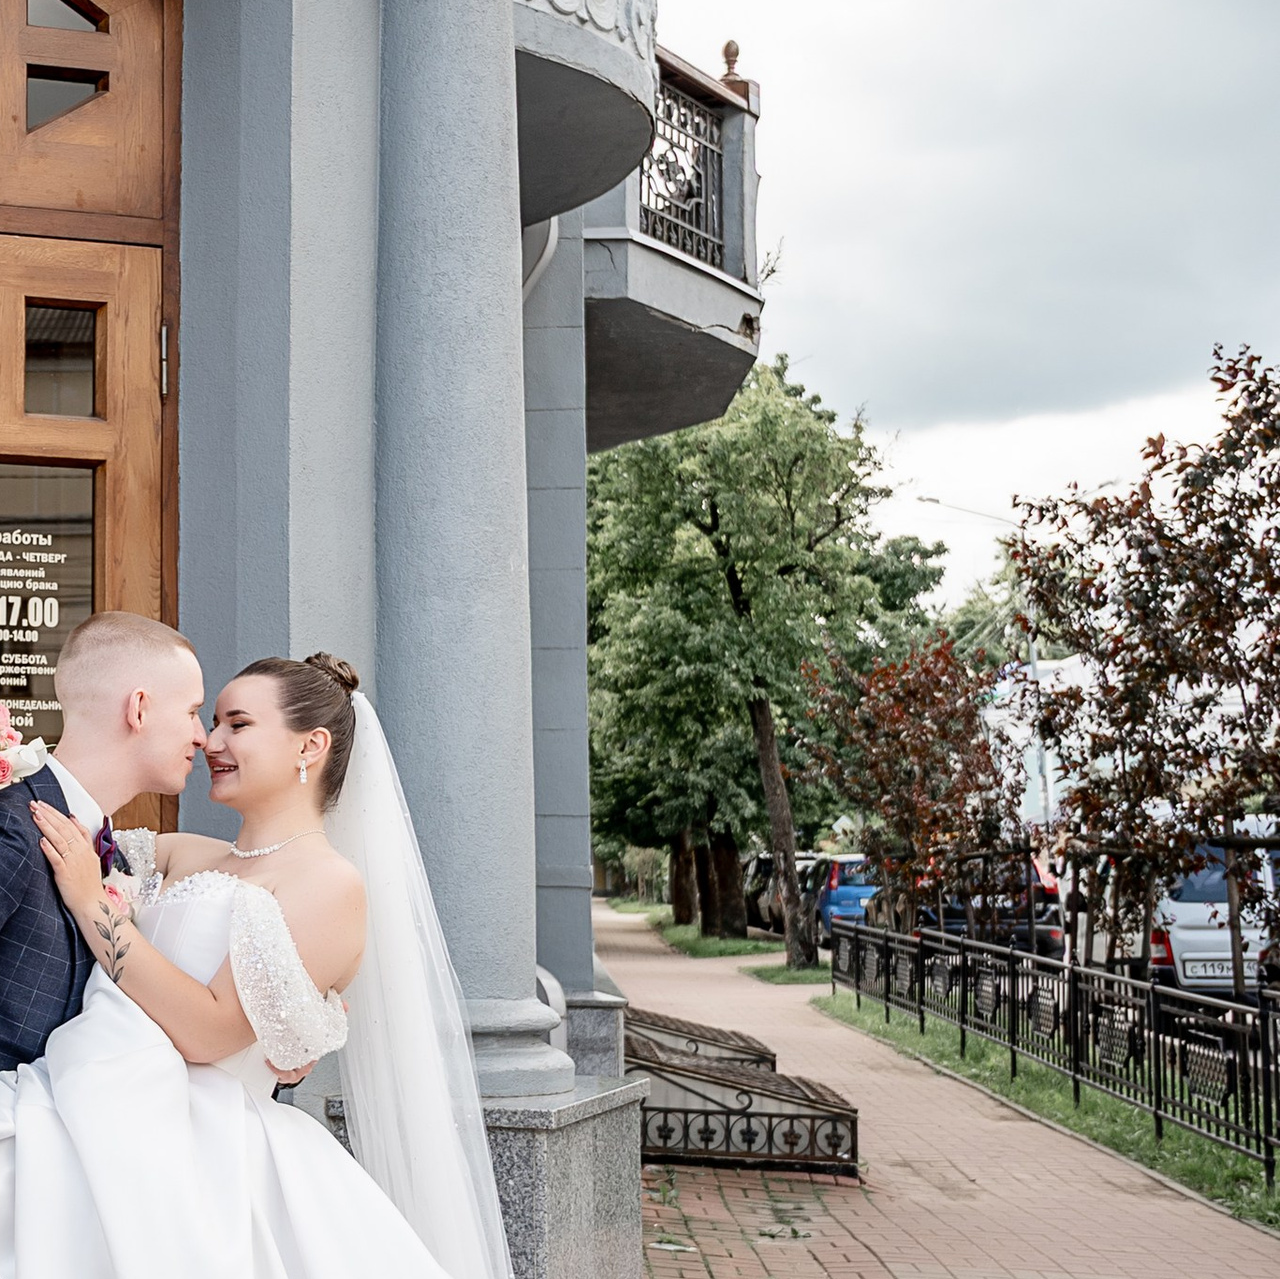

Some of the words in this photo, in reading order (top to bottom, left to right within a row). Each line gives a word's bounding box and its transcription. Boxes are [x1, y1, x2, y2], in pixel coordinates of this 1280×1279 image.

[22, 552, 67, 564] ЧЕТВЕРГ
[25, 579, 58, 591] брака
[1, 653, 48, 665] СУББОТА
